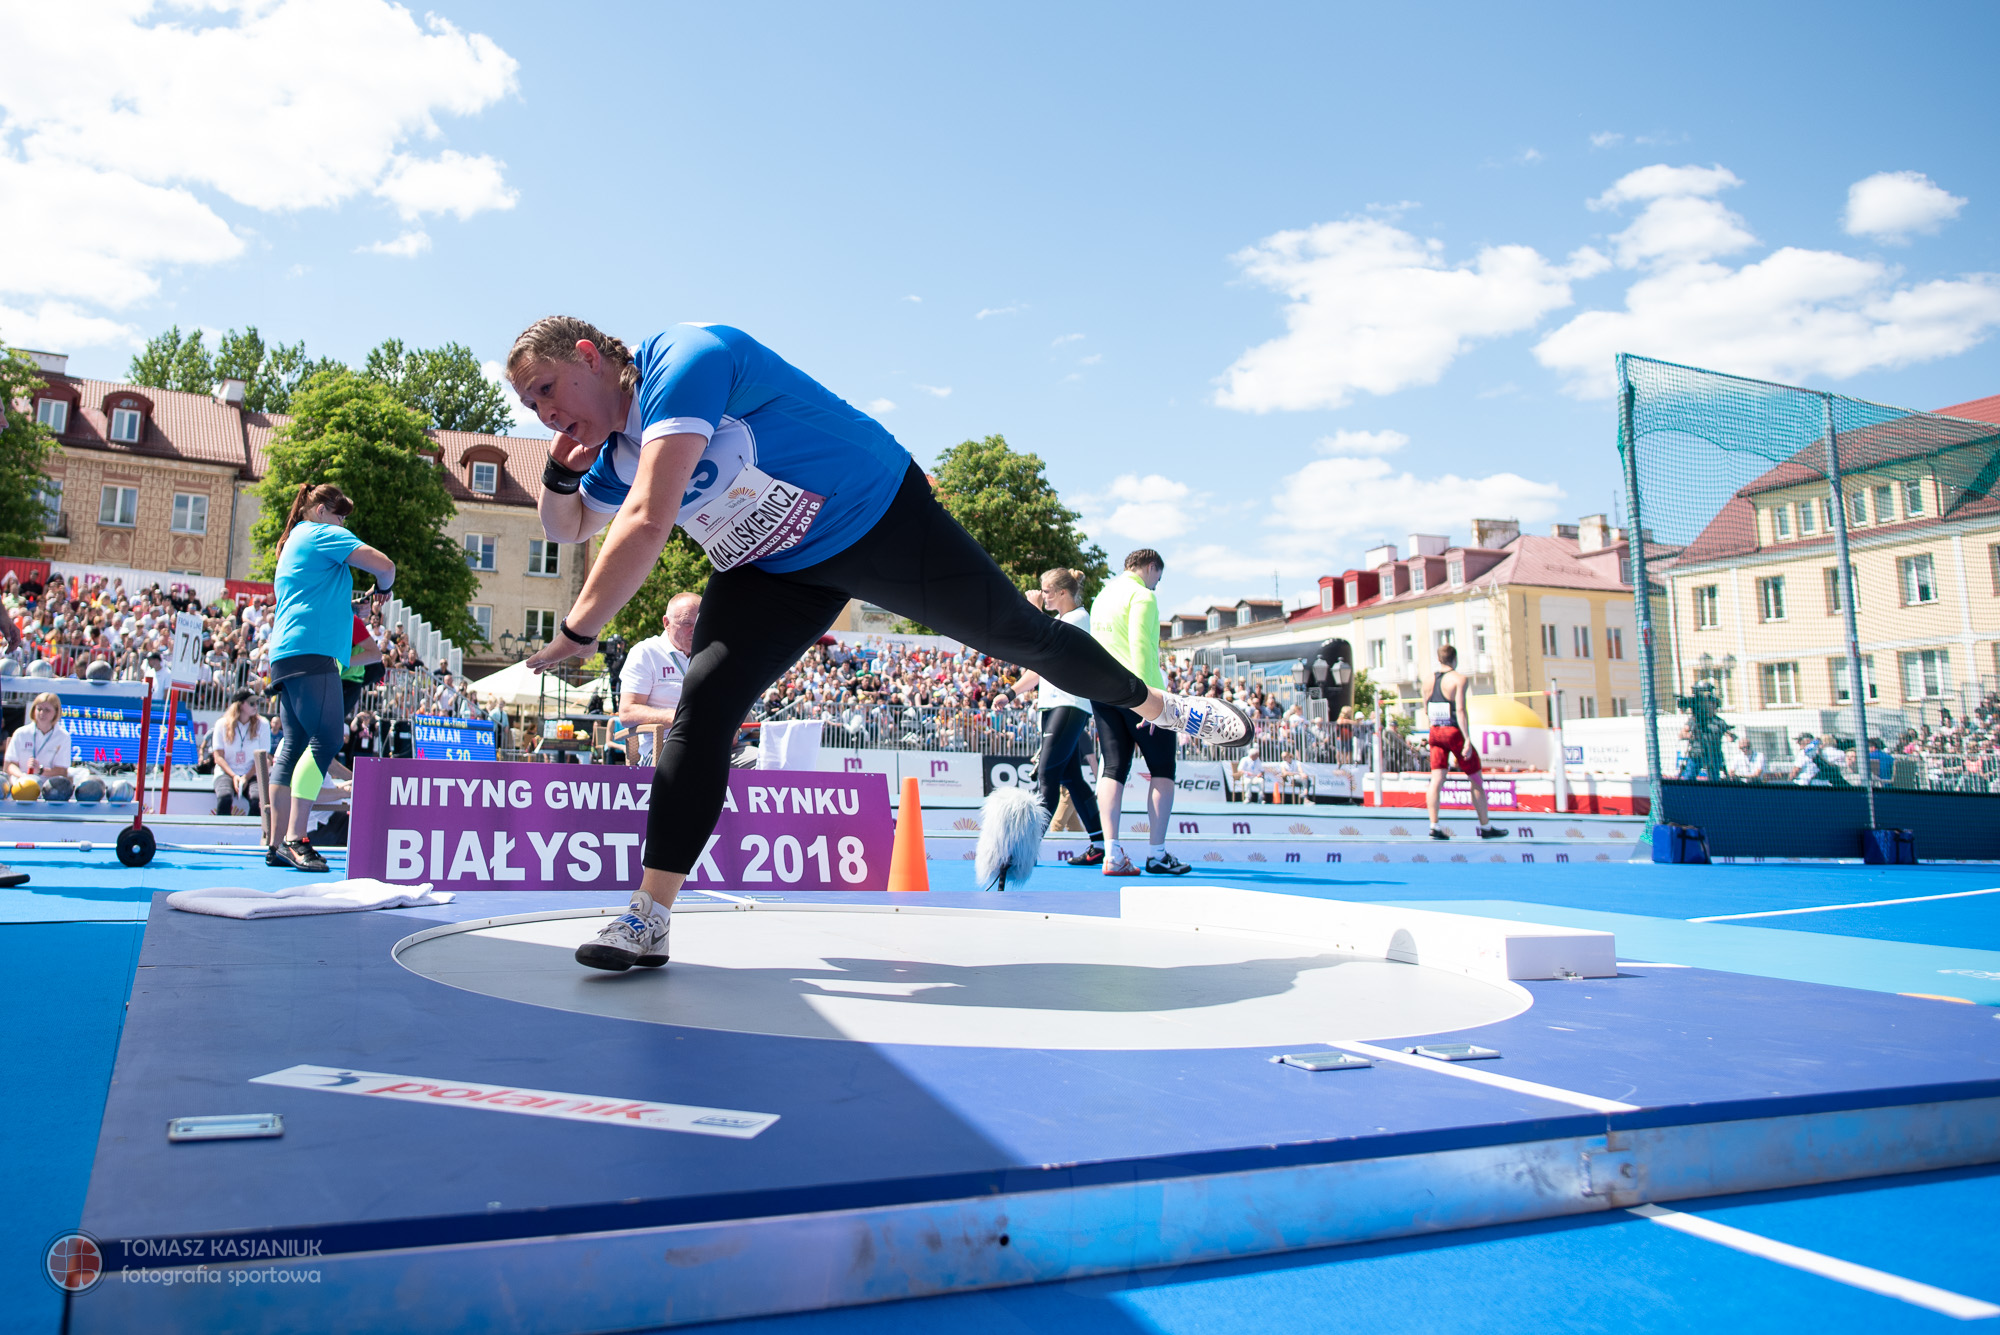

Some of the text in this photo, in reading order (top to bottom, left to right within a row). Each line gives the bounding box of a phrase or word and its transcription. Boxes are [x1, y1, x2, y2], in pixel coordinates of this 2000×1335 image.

[709, 484, 799, 570] MALUŚKIEWICZ
[756, 534, 782, 556] GWIAZD
[778, 525, 791, 537] NA
[789, 498, 809, 525] RYNKU
[796, 501, 821, 532] 2018
[180, 632, 200, 664] 70
[415, 726, 494, 745] DZAMAN POL
[1185, 707, 1203, 736] NIKE
[390, 777, 860, 815] MITYNG GWIAZ A RYNKU
[1487, 792, 1512, 805] 2018
[385, 829, 868, 884] BIAŁYSTK 2018
[363, 1082, 666, 1120] polanik
